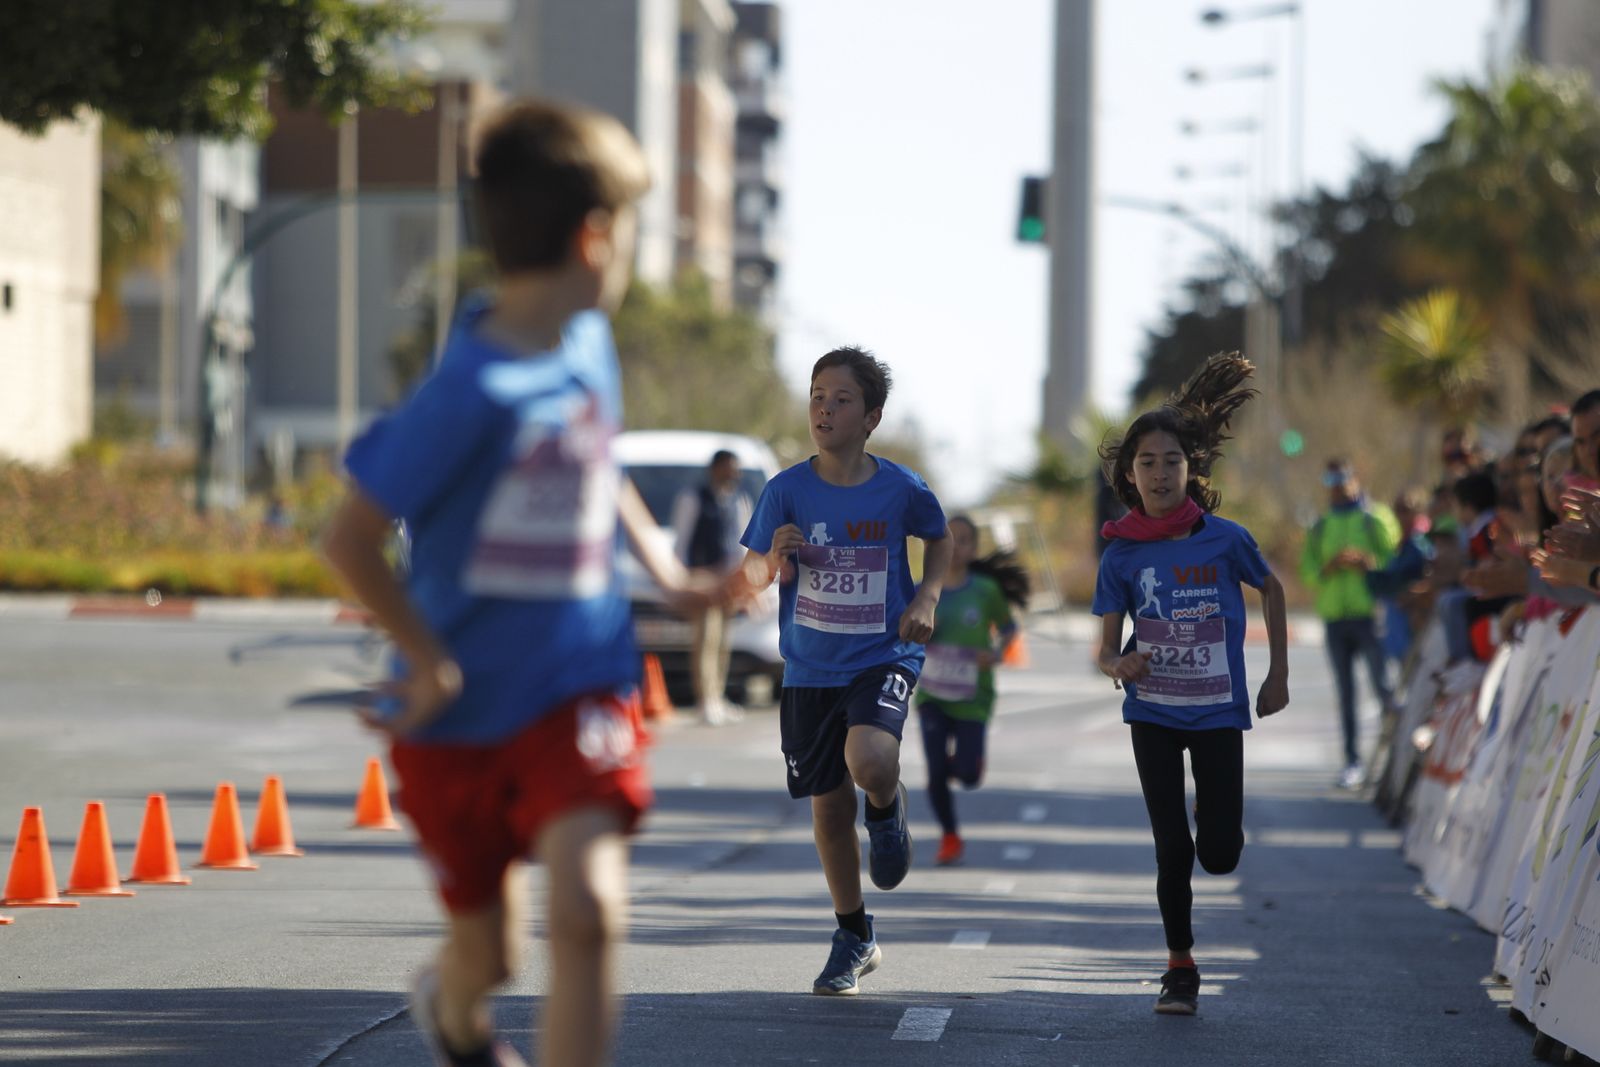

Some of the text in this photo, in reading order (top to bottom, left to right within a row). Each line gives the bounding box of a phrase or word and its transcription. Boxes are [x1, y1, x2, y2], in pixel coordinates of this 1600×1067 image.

[846, 520, 888, 542] VIII
[809, 570, 869, 594] 3281
[1172, 564, 1217, 586] VIII
[1172, 588, 1219, 598] CARRERA
[1150, 645, 1211, 668] 3243
[882, 673, 908, 702] 10
